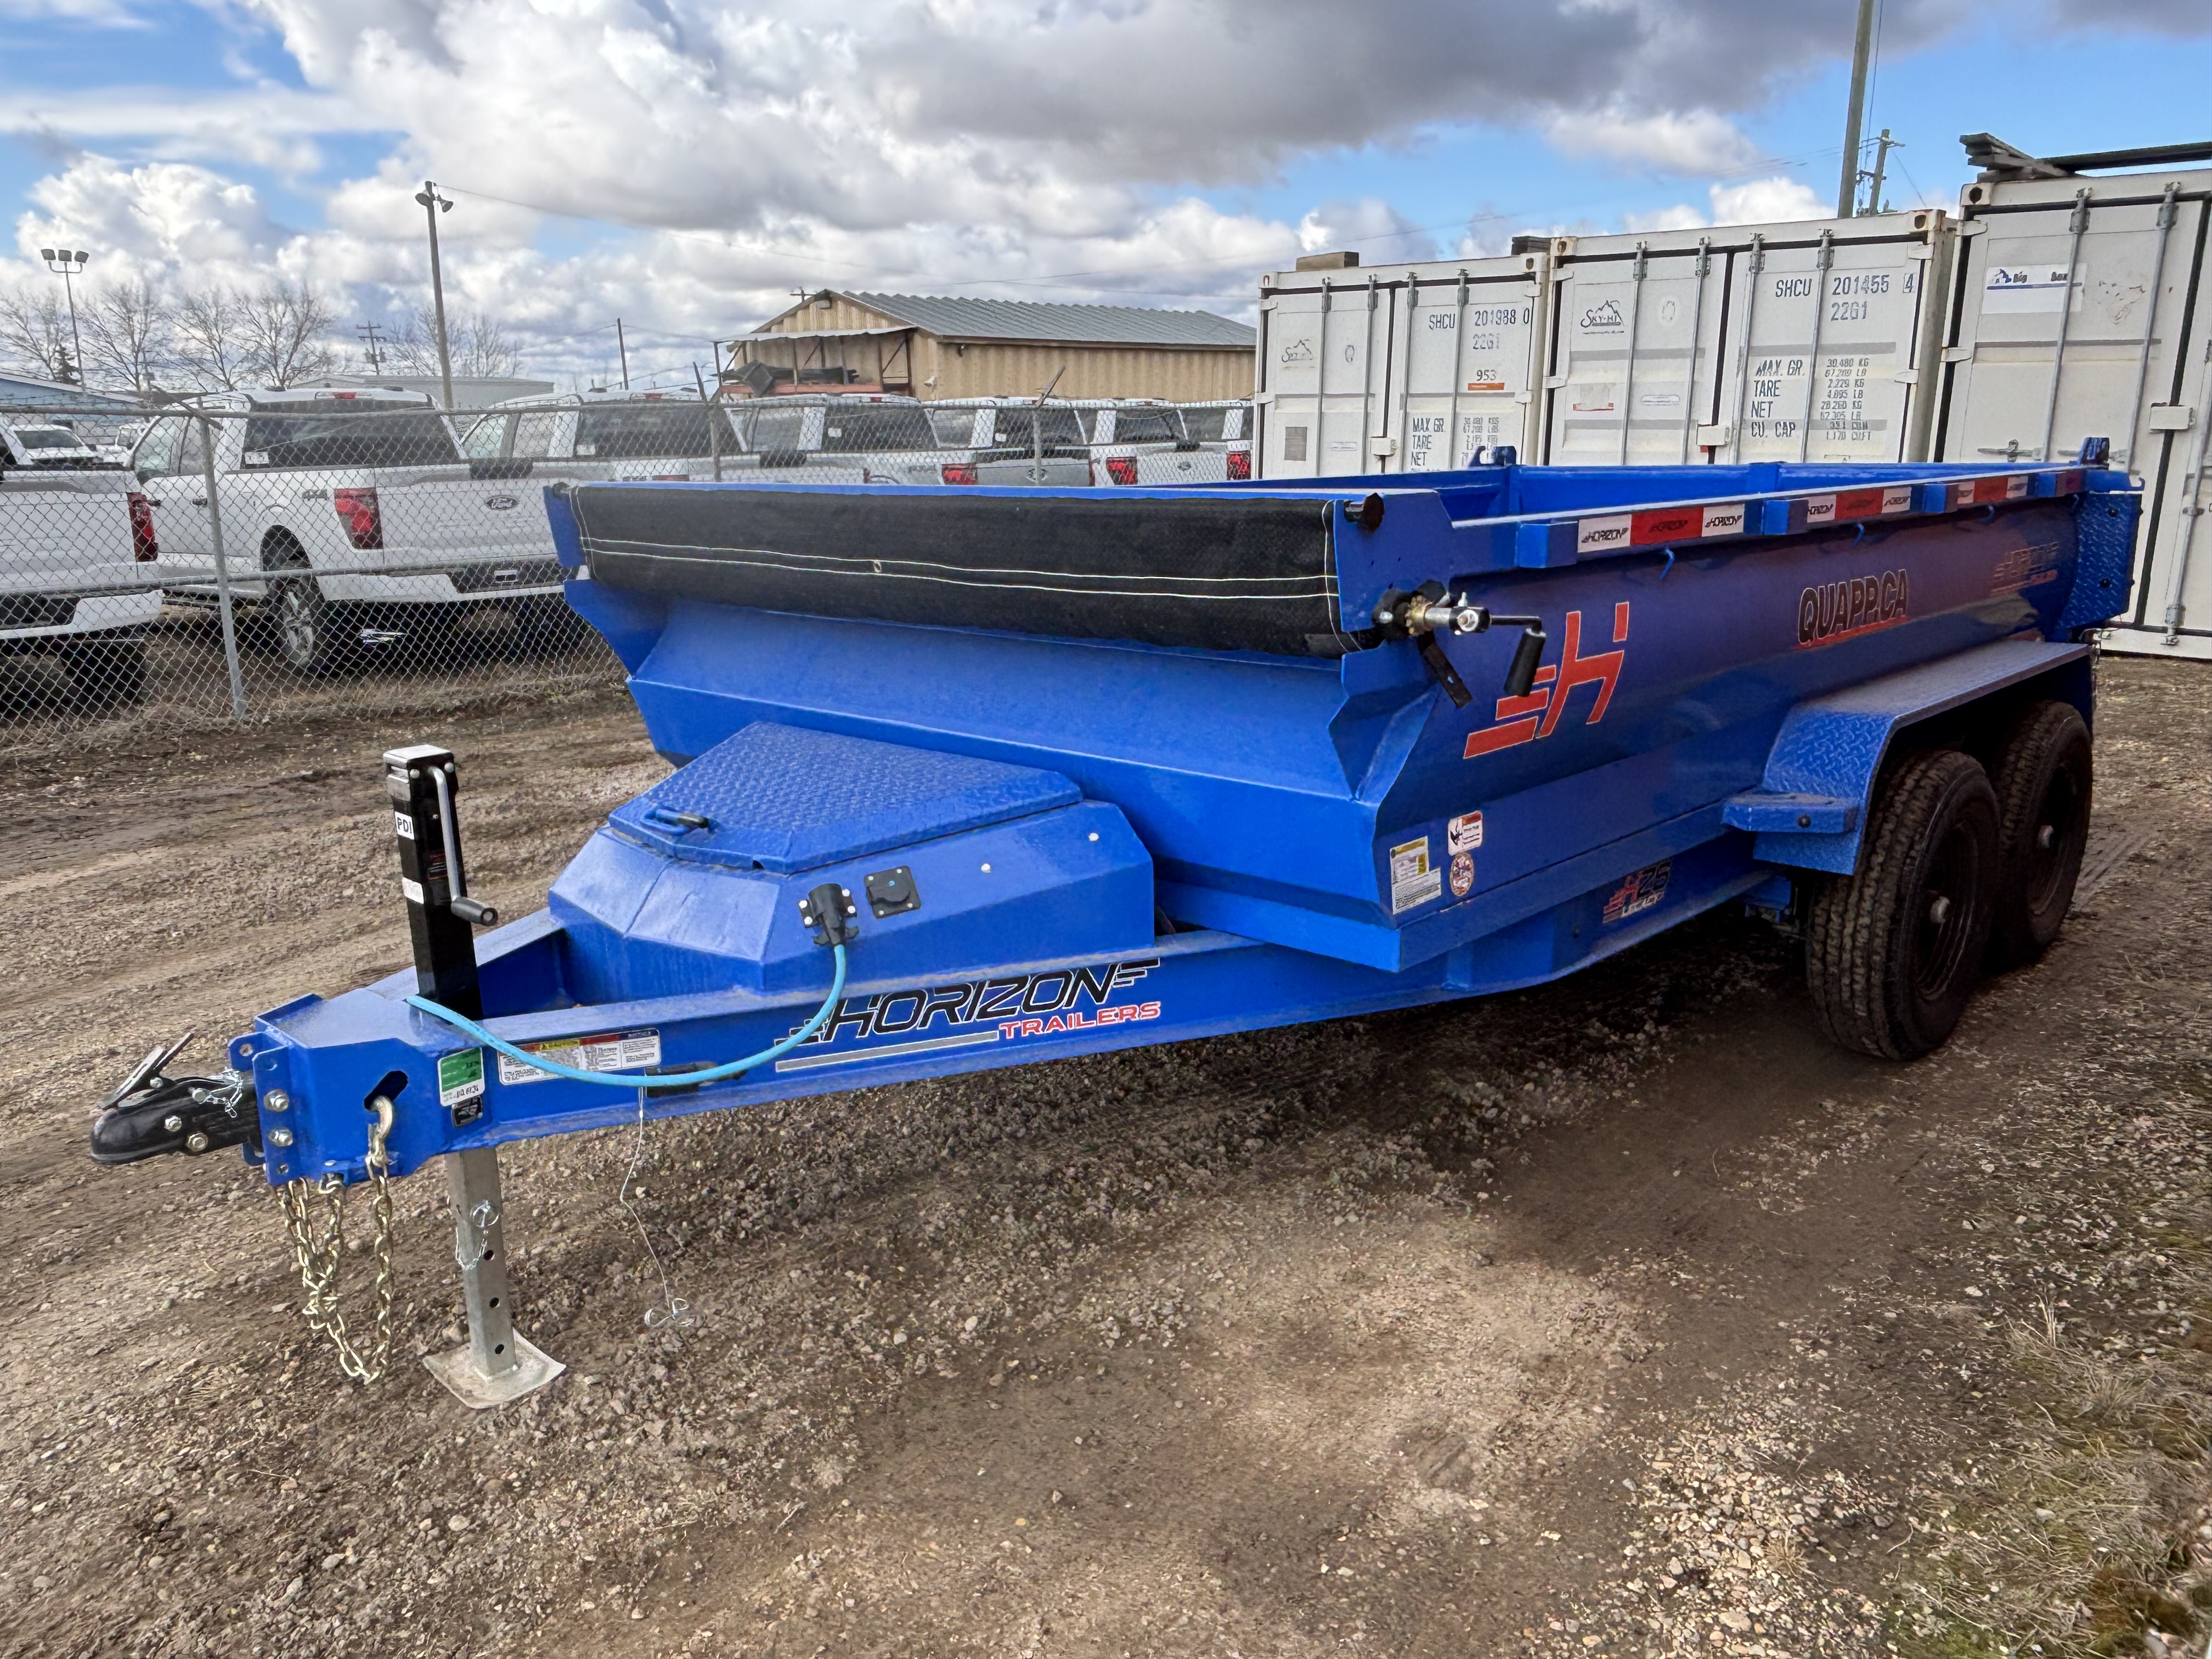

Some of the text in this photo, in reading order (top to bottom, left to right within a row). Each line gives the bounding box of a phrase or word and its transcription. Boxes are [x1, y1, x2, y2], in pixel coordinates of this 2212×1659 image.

[1775, 273, 1914, 298] SHCU 201455 4
[1429, 313, 1455, 330] SHCU
[1754, 380, 1781, 397] TARE
[1751, 401, 1773, 418] NET
[1413, 417, 1430, 432] MAX
[1411, 452, 1426, 466] NET
[397, 817, 413, 834] PDI
[822, 961, 1120, 1043] HORIZON
[998, 1002, 1162, 1040] TRAILERS
